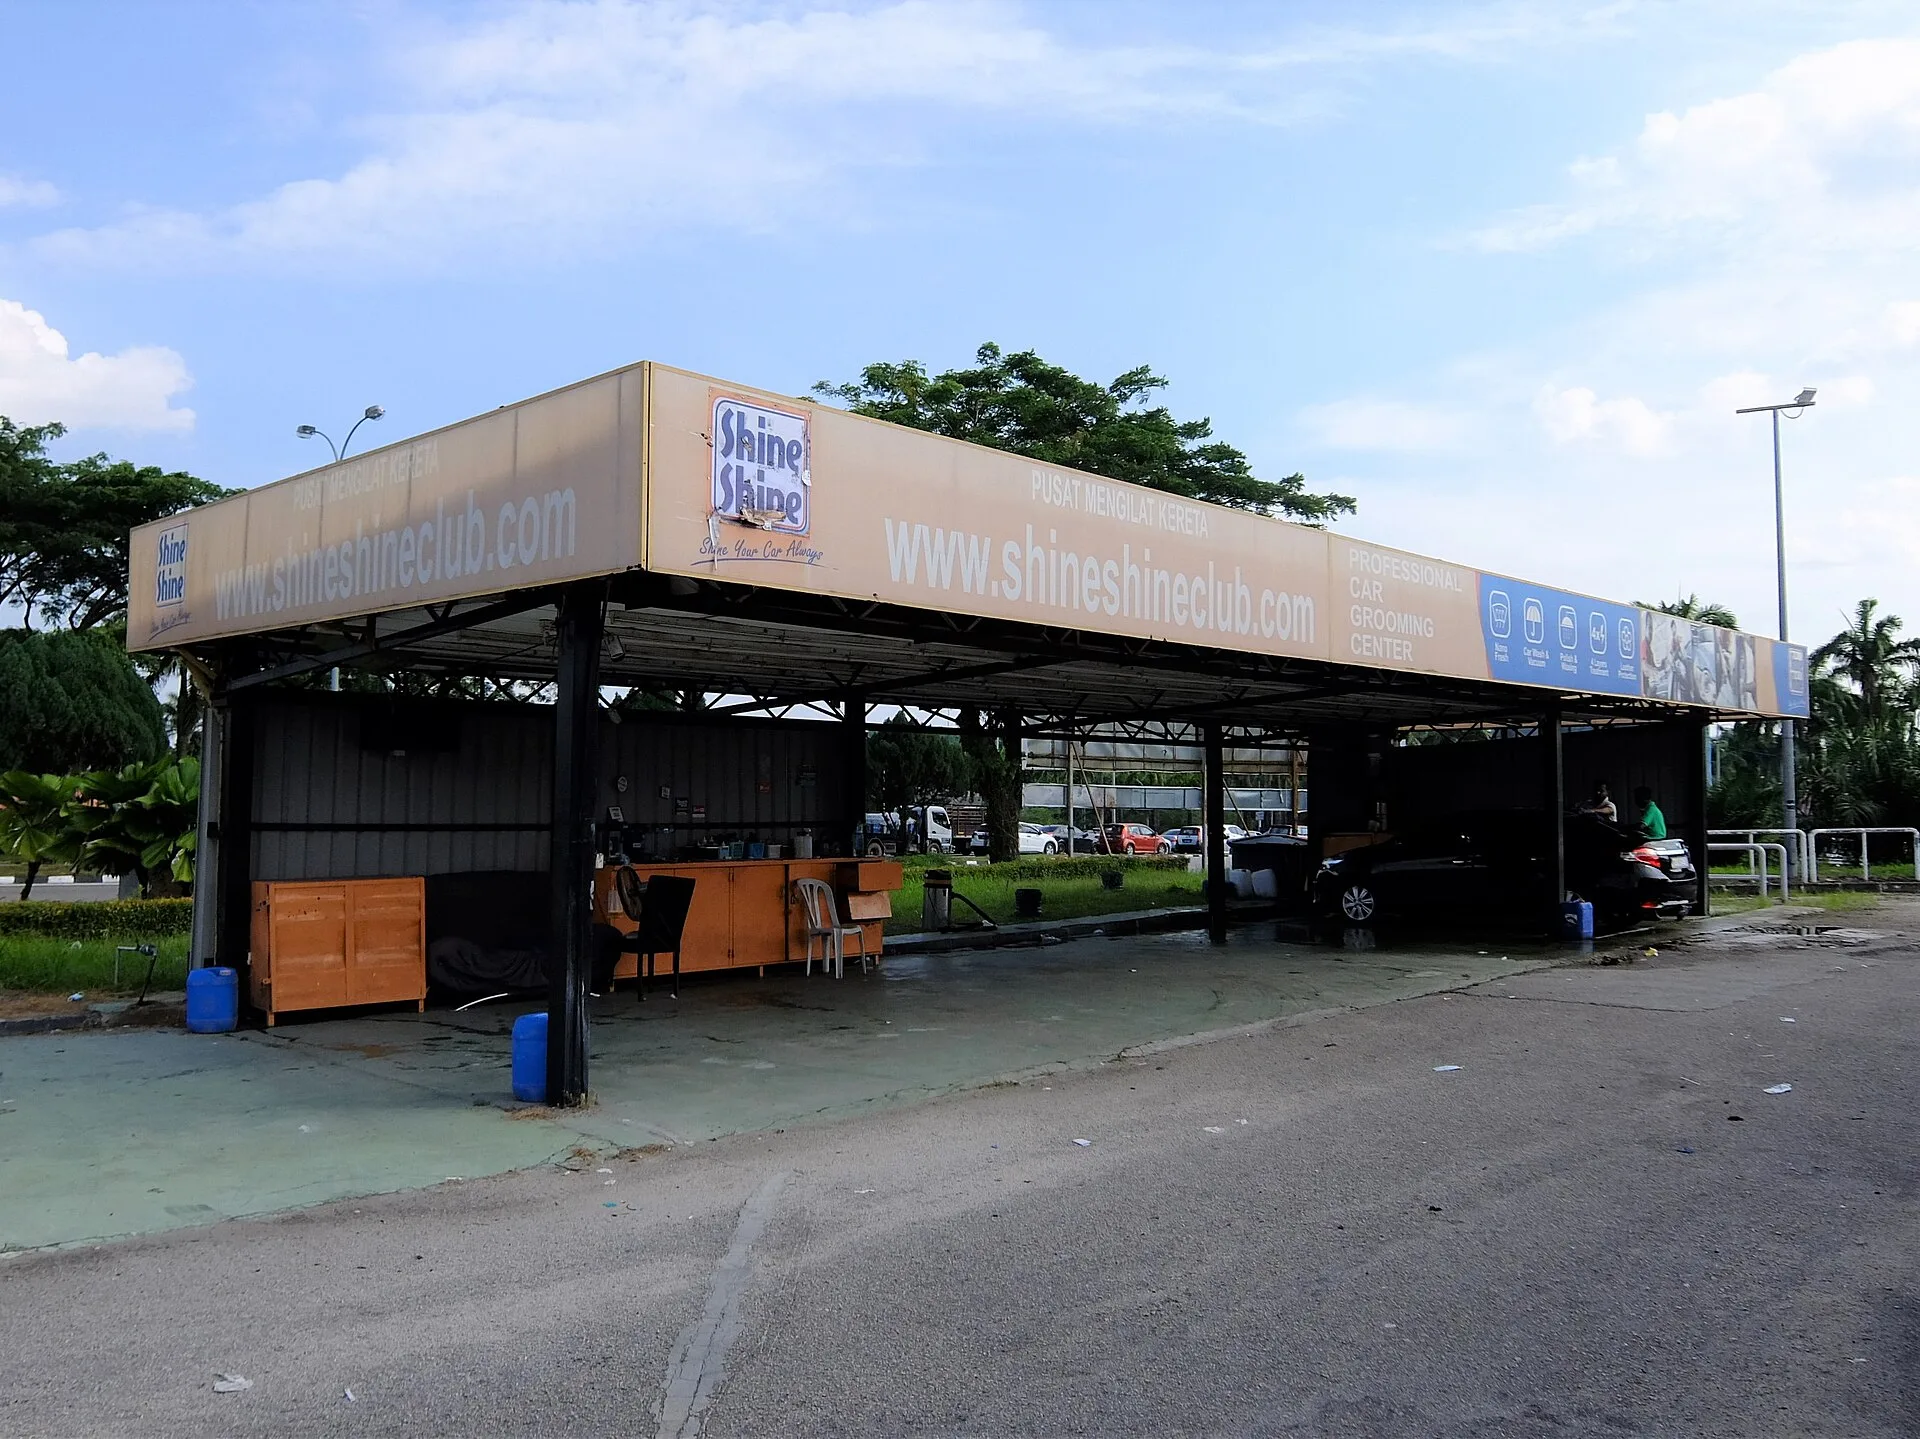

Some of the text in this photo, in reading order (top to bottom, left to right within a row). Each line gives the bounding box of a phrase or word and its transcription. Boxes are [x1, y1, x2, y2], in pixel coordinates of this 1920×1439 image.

[720, 407, 803, 473] Shine
[719, 462, 801, 525] Shine
[1031, 469, 1209, 539] PUSAT MENGILAT KERETA
[158, 532, 185, 567] Shine
[214, 485, 576, 621] www.shineshineclub.com
[700, 537, 824, 564] Shine Your Car Always
[156, 568, 184, 602] Shine
[884, 516, 1315, 643] www.shineshineclub.com
[1349, 548, 1463, 593] PROFESSIONAL
[1350, 576, 1384, 603] CAR
[1350, 604, 1434, 638] GROOMING
[1351, 632, 1414, 662] CENTER
